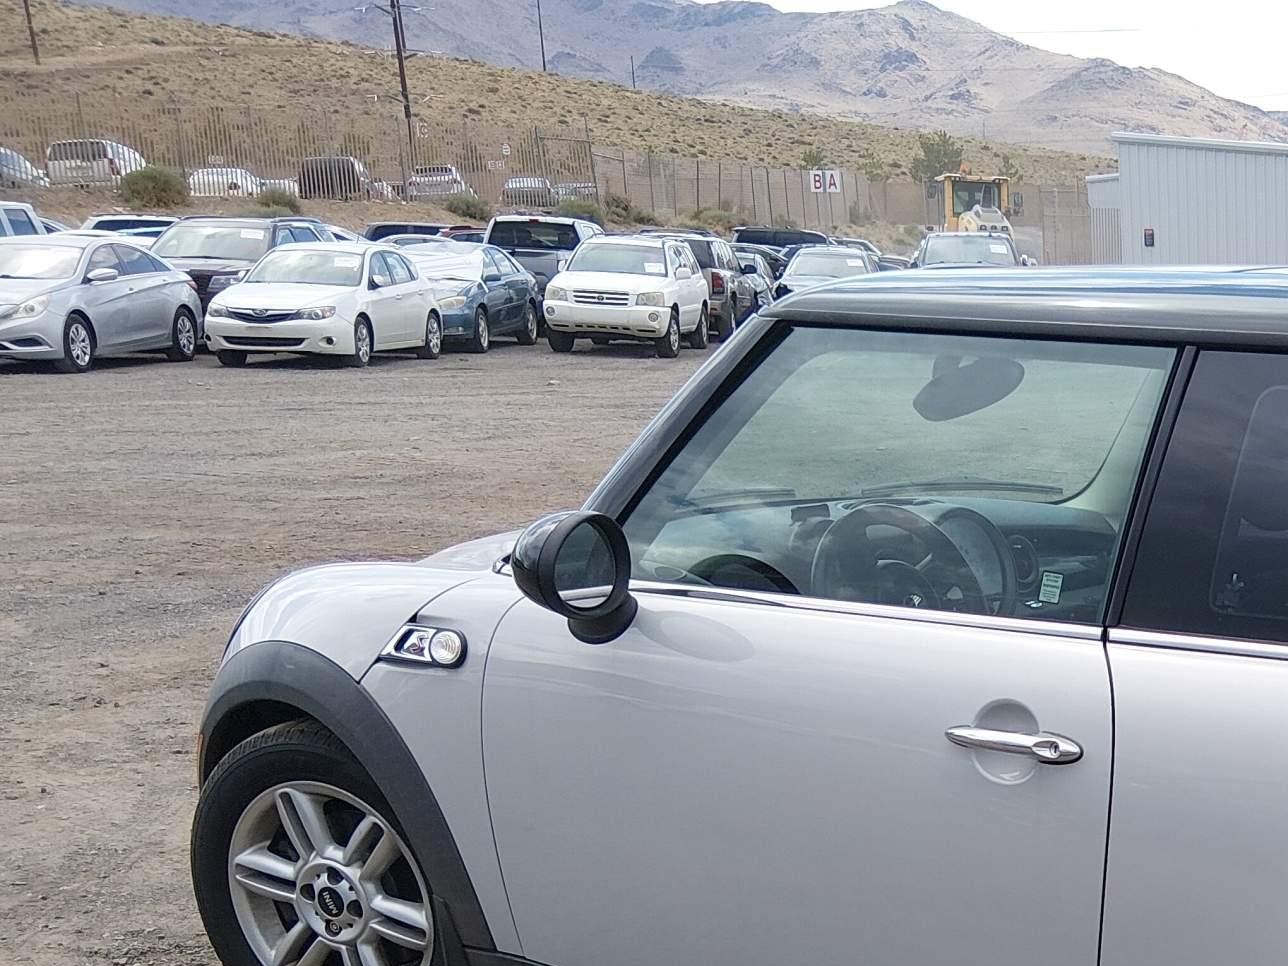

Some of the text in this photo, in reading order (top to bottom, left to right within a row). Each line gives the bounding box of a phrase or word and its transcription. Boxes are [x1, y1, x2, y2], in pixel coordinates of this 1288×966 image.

[813, 173, 838, 190] B A
[322, 891, 339, 914] MINI
